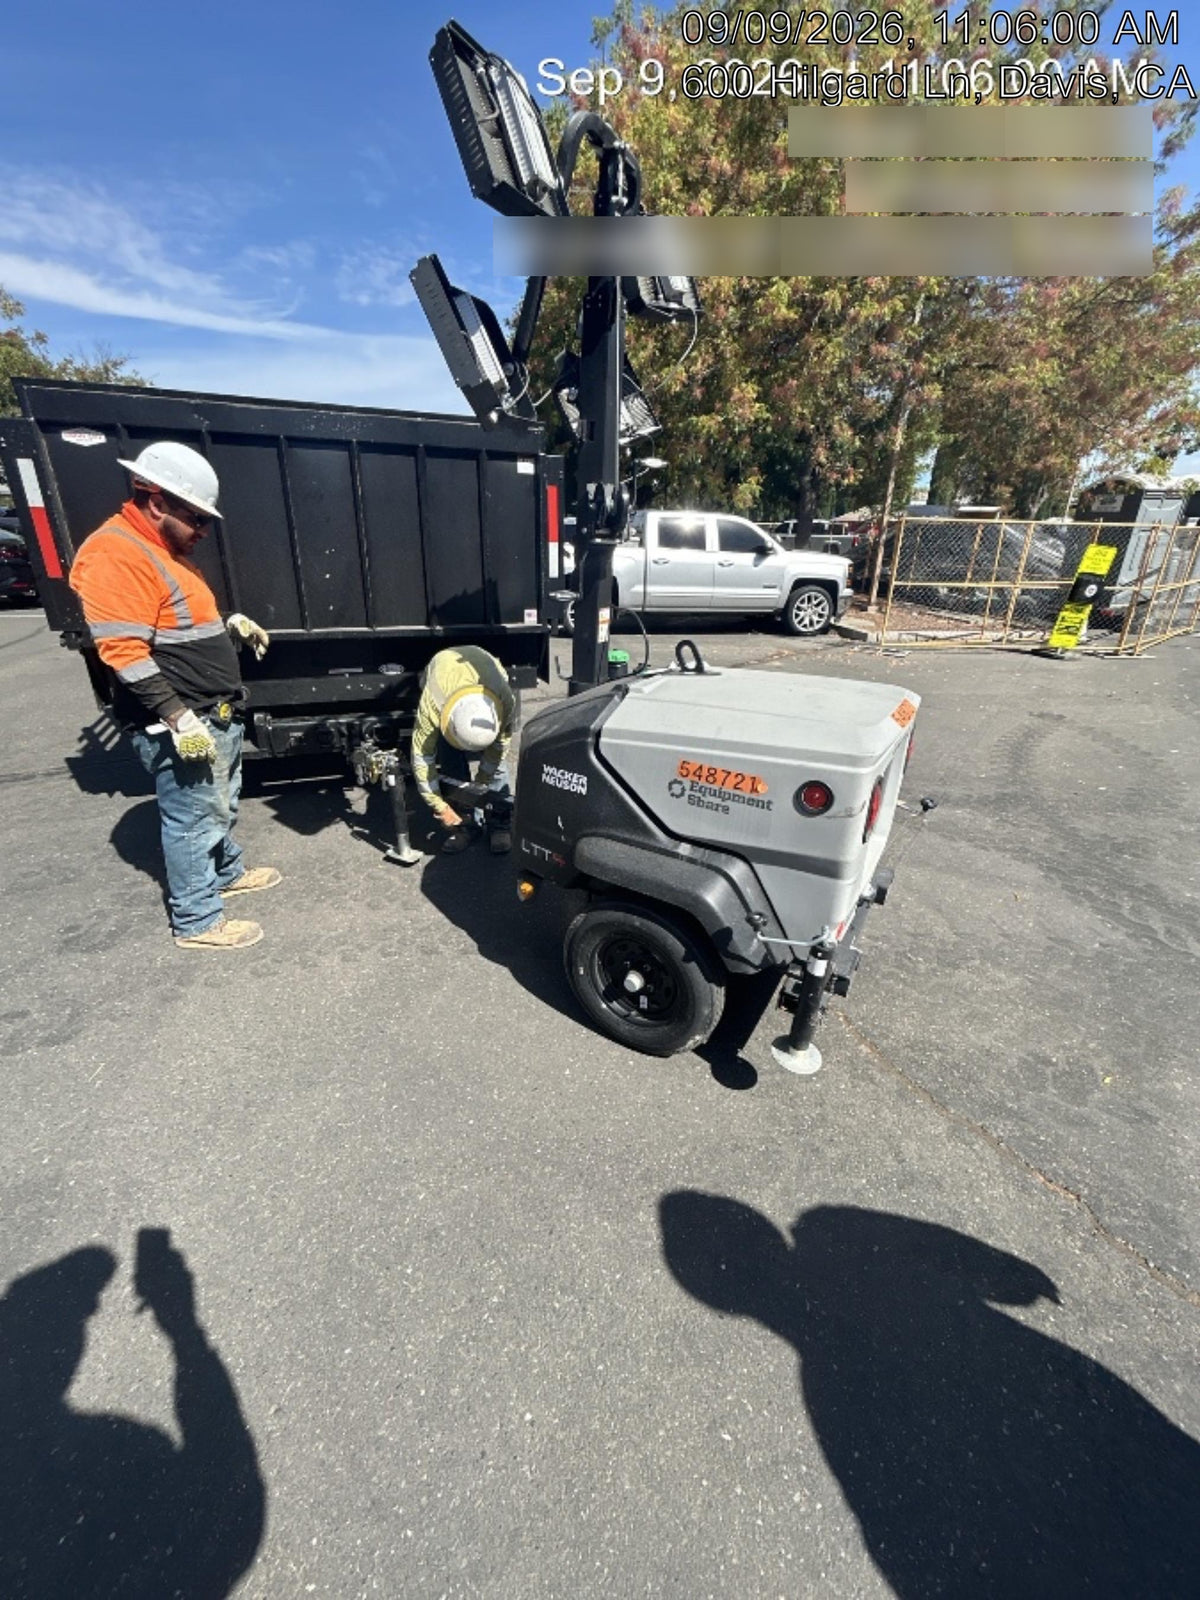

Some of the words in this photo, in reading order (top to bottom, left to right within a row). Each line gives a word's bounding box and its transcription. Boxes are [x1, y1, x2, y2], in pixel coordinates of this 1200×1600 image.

[541, 772, 588, 796] NEUSON
[543, 763, 588, 785] WACKER
[678, 760, 760, 794] 548721
[687, 793, 730, 815] Share
[689, 780, 774, 812] Equipment
